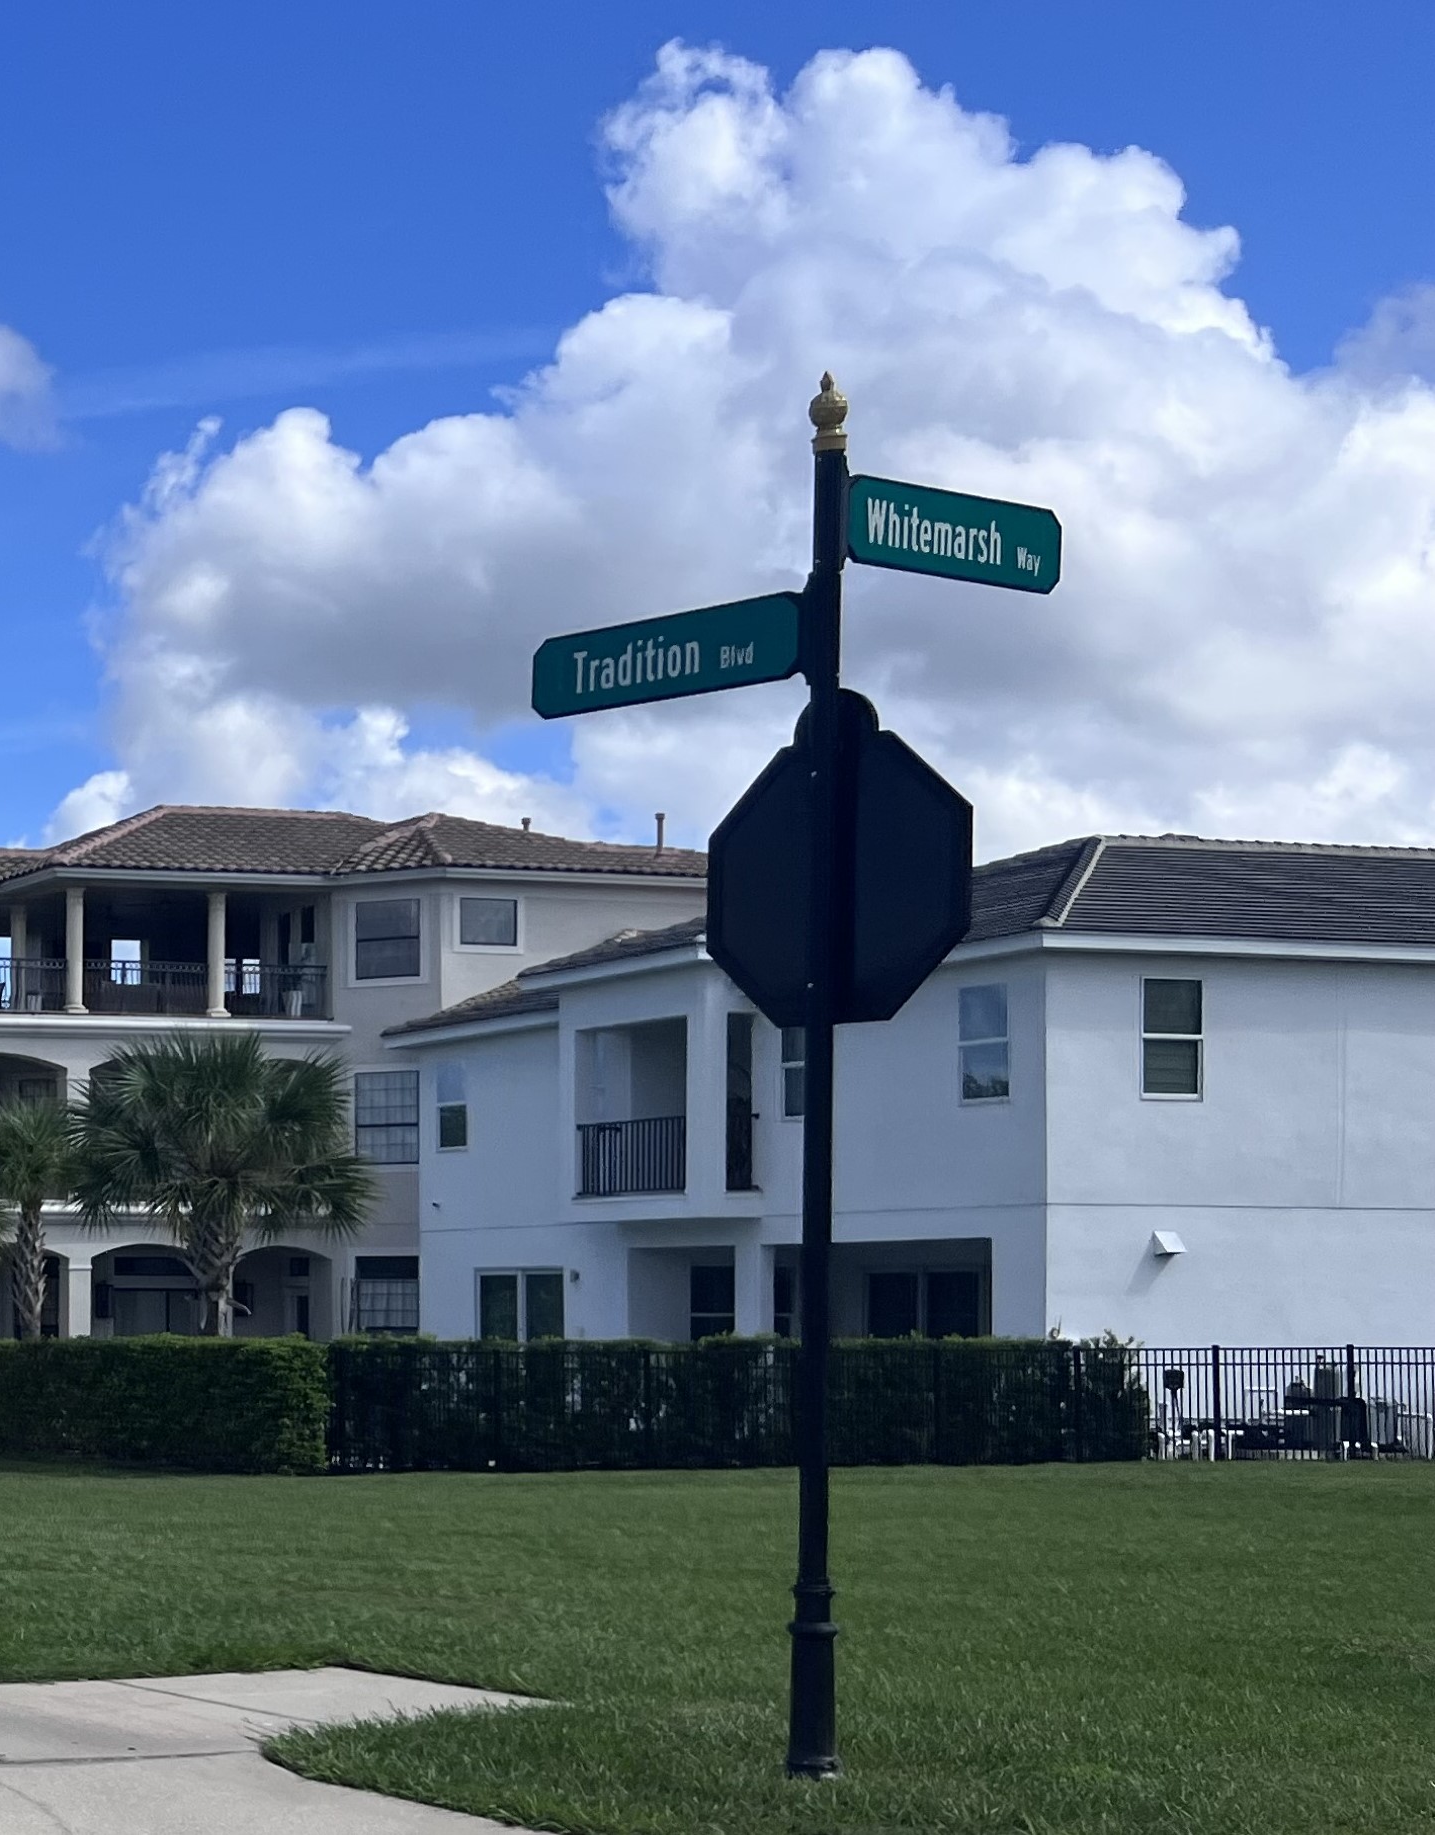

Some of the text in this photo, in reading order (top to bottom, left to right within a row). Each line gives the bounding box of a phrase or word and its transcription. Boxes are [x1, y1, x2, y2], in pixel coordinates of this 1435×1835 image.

[867, 497, 1041, 577] Whitemarsh Way
[573, 636, 754, 694] Tradition Blvd
